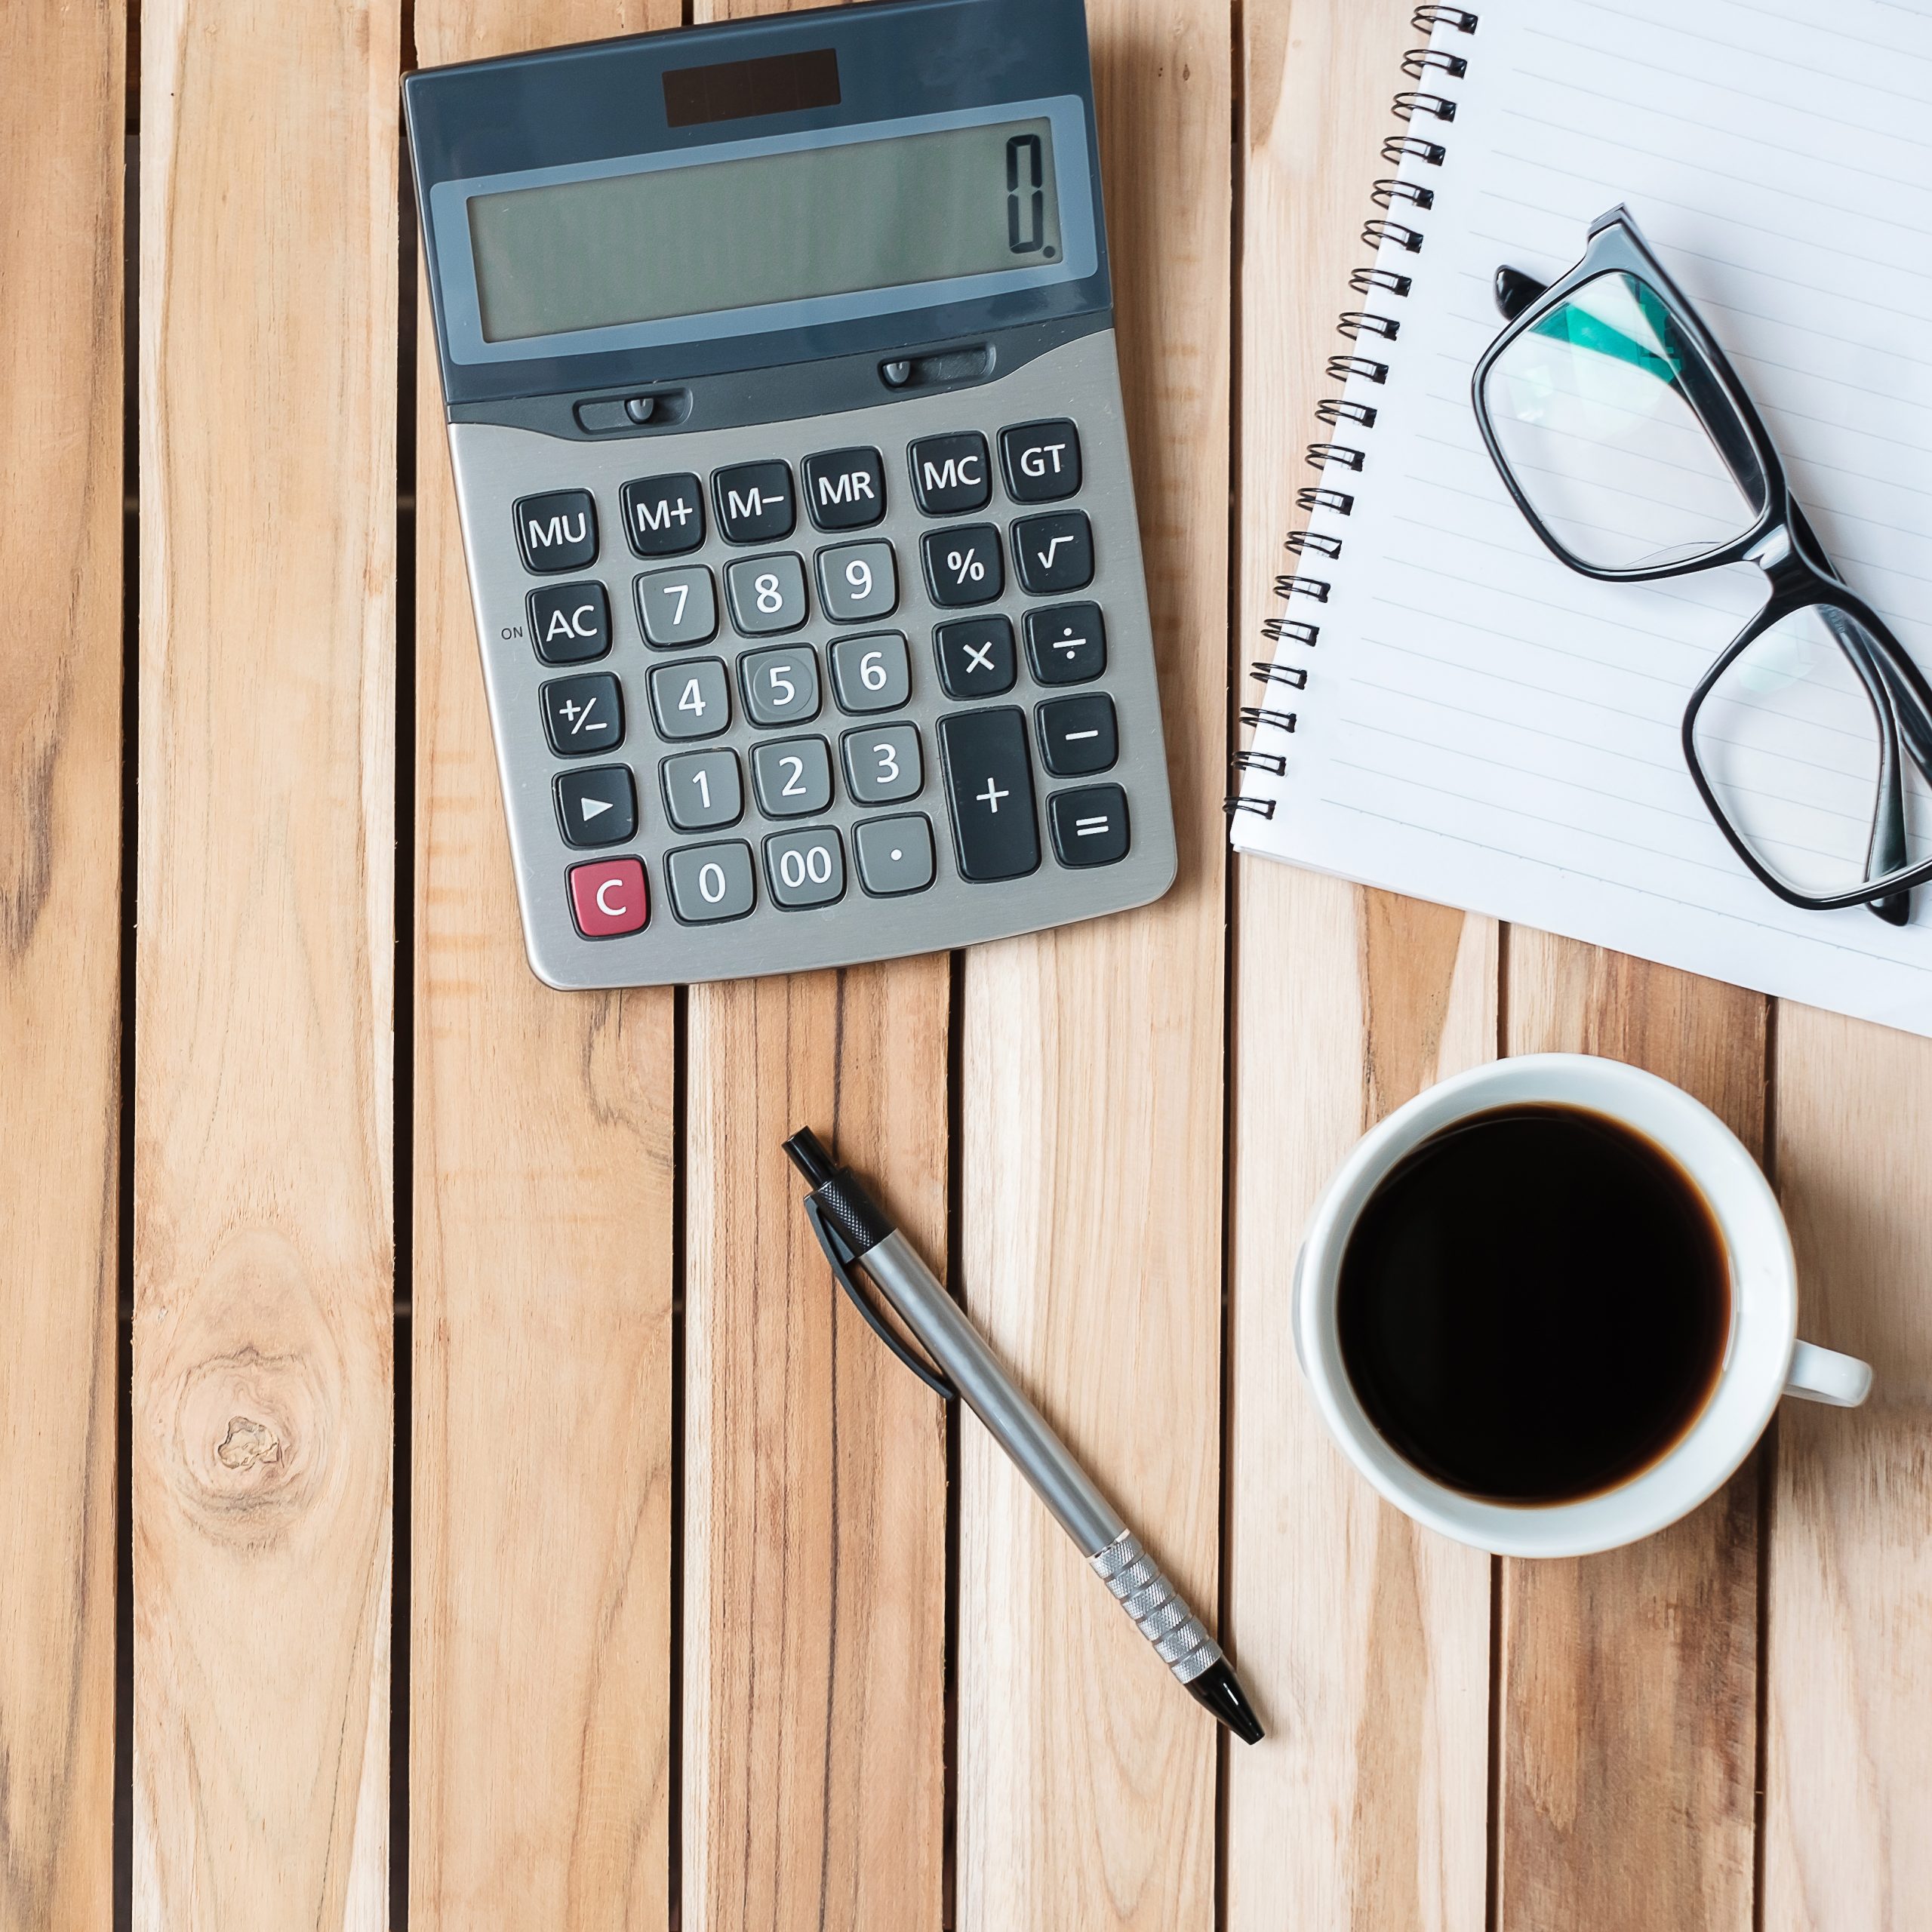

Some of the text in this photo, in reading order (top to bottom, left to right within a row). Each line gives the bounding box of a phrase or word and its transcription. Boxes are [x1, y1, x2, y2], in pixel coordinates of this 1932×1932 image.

[923, 455, 981, 491] MC
[1020, 443, 1066, 477] GT
[818, 471, 875, 506] MR
[528, 512, 586, 549] MU
[636, 497, 693, 532] M+
[845, 560, 872, 599] 9
[947, 548, 985, 584] %
[663, 584, 689, 625] 7
[755, 574, 783, 613] 8
[501, 626, 523, 640] ON
[546, 605, 598, 642] AC
[769, 666, 795, 706] 5
[860, 651, 887, 691] 6
[678, 678, 706, 716] 4
[779, 756, 807, 796] 2
[873, 743, 899, 783] 3
[692, 770, 711, 808] 1
[699, 863, 726, 903] 0
[780, 846, 832, 888] 00
[596, 879, 626, 916] C
